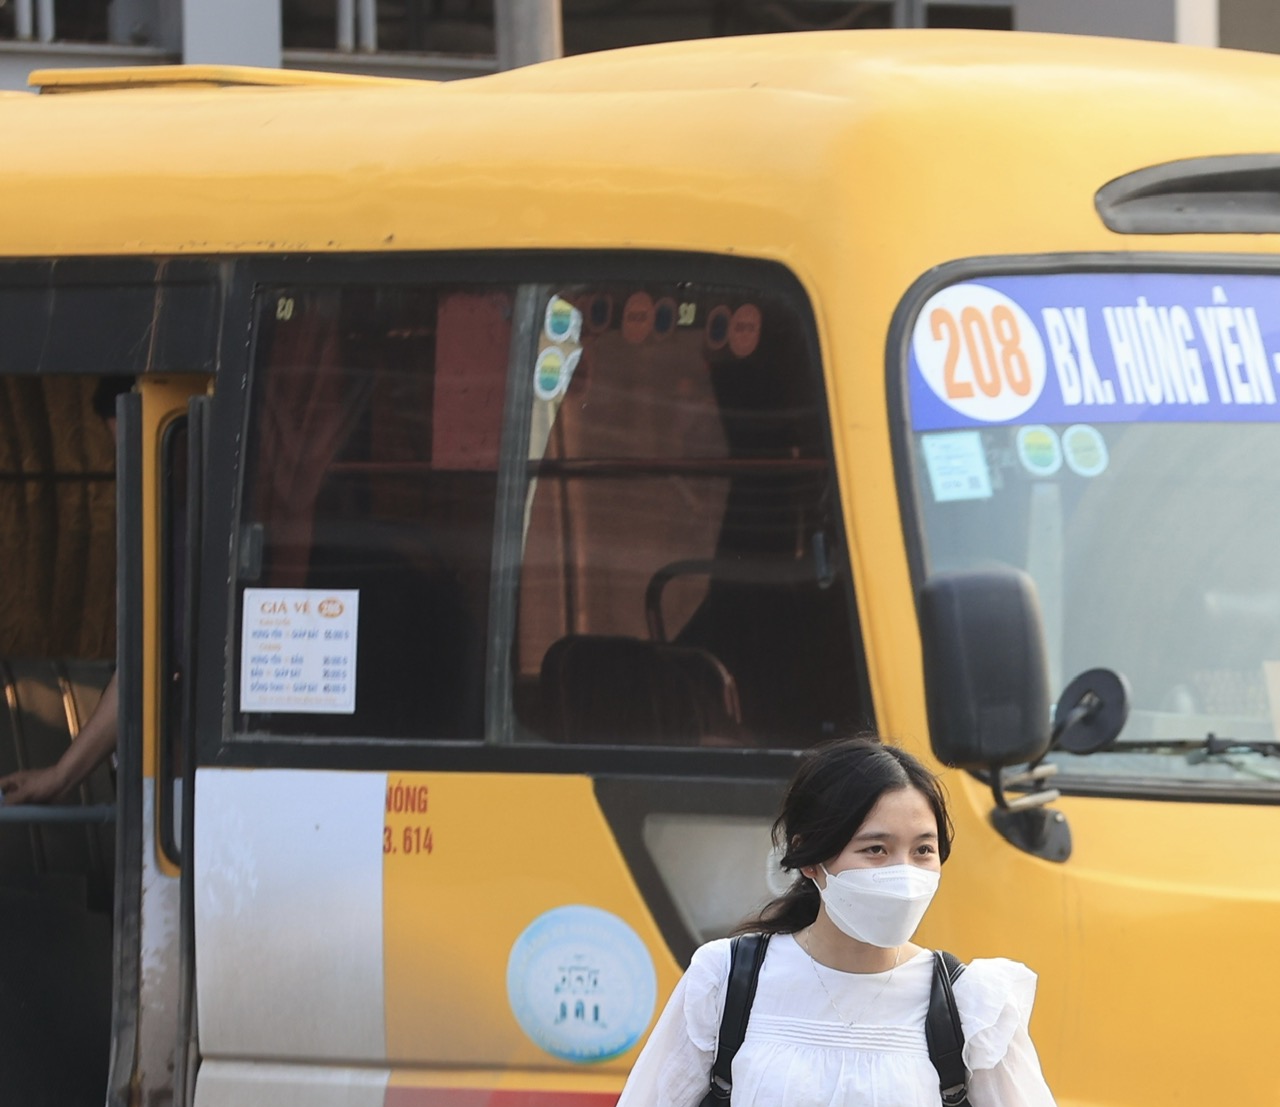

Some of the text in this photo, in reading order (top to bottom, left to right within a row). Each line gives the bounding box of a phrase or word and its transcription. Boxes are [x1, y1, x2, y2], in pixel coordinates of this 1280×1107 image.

[929, 304, 1032, 399] 208
[1042, 306, 1116, 405] BX.
[1195, 286, 1277, 405] YÊN
[402, 825, 433, 855] 614
